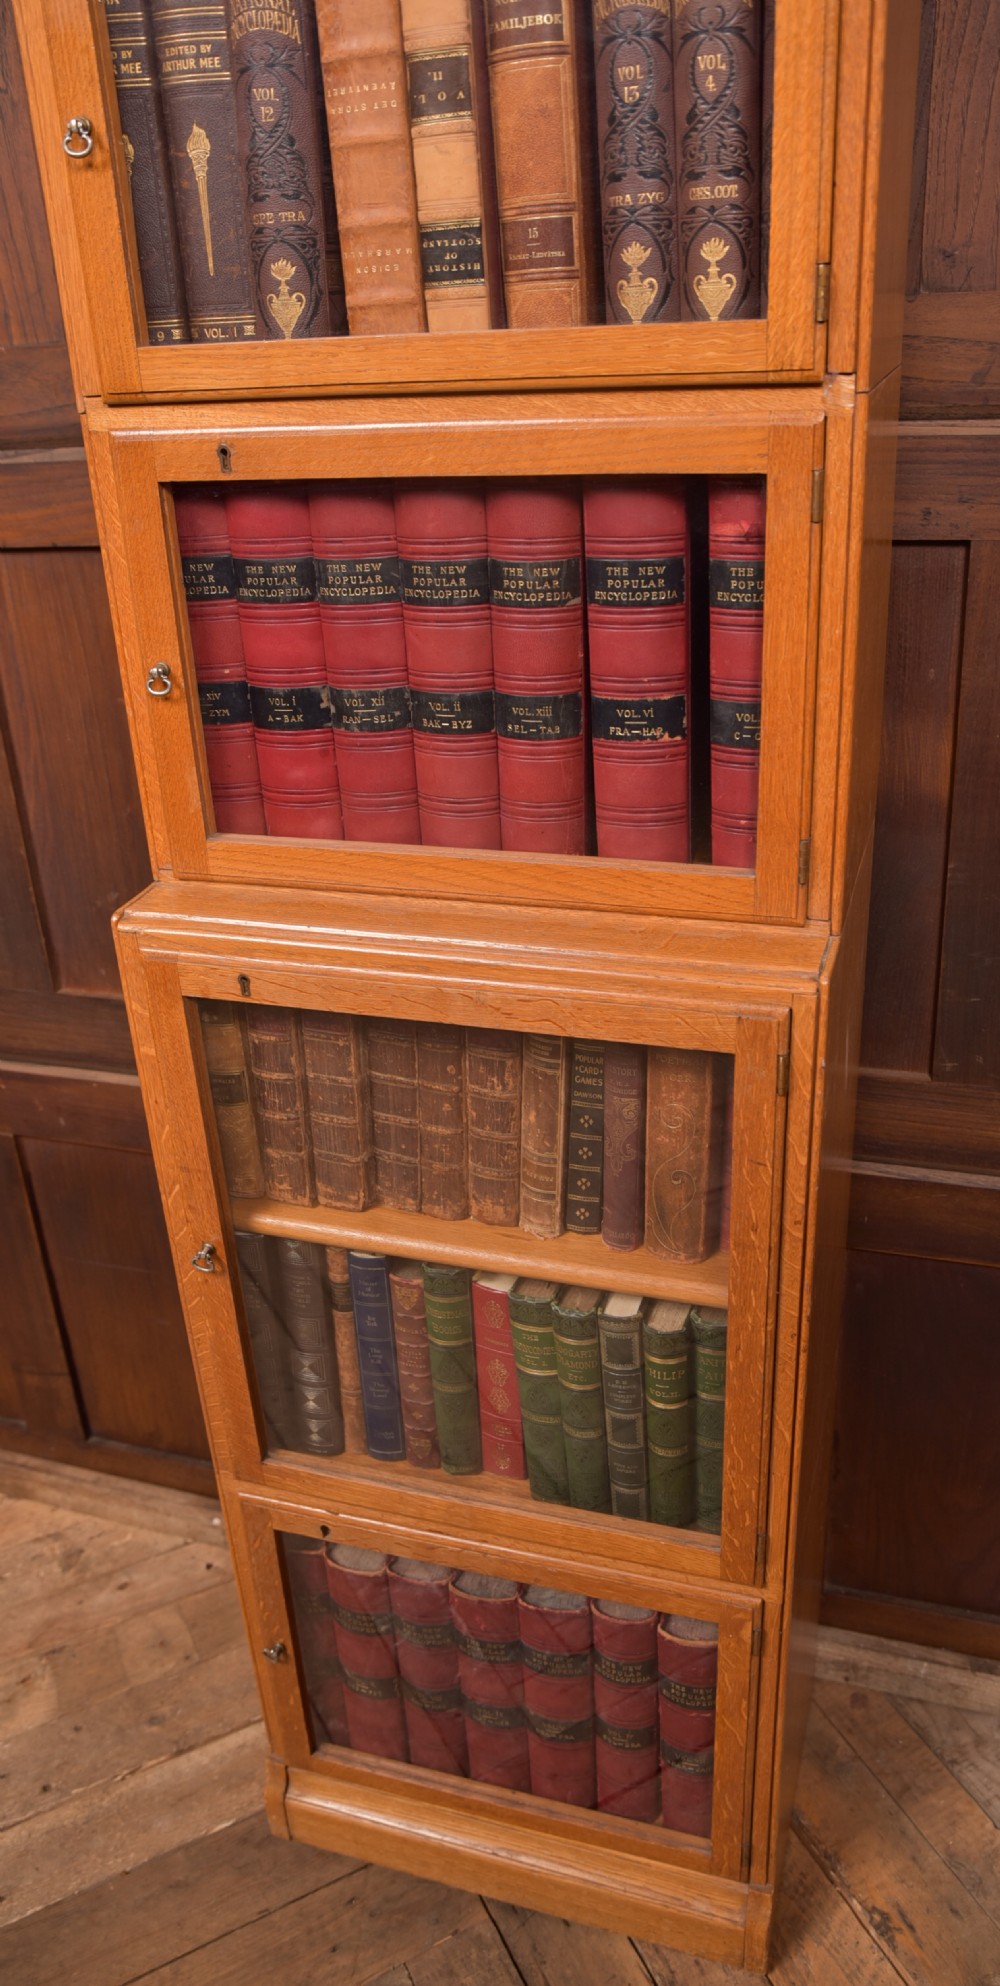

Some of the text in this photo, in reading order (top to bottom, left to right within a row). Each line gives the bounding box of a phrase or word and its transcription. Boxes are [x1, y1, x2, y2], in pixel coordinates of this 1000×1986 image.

[489, 14, 563, 33] AMILJEBOK
[121, 50, 132, 59] BY
[165, 44, 212, 57] EDITED BY
[162, 56, 221, 72] ARTHUR MEE
[697, 54, 726, 70] VOL
[120, 62, 142, 74] MEE
[617, 65, 644, 81] VOL
[705, 75, 716, 91] 4
[624, 86, 640, 103] 13
[374, 100, 397, 109] DET
[260, 106, 275, 122] 12
[279, 210, 306, 222] TRA
[528, 227, 539, 238] 15
[422, 237, 481, 249] SCOTLAND
[444, 252, 458, 260] OF
[204, 328, 229, 338] VOL.
[189, 563, 215, 572] NEW
[245, 565, 297, 574] THE NEW
[326, 563, 383, 573] THE NEW
[412, 566, 467, 575] THE NEW
[503, 568, 560, 576] THE NEW
[606, 566, 666, 575] THE NEW
[730, 568, 754, 576] THE
[247, 577, 298, 585] POPULAR
[328, 575, 382, 585] POPULAR
[413, 578, 467, 587] POPULAR
[503, 580, 560, 589] POPULAR
[607, 579, 665, 588] POPULAR
[239, 587, 312, 597] ENCYCLOPEDIA
[319, 585, 396, 596] ENCYCLOPEDIA
[404, 588, 480, 598] ENCYCLOPEDIA
[594, 590, 678, 601] ENCYCLOPEDIA
[493, 590, 573, 602] ENCYCLOPEDIA
[616, 709, 641, 718] VOL.
[575, 1054, 604, 1065] POPULAR
[574, 1075, 603, 1086] GAMES
[573, 1090, 602, 1100] DAWSON
